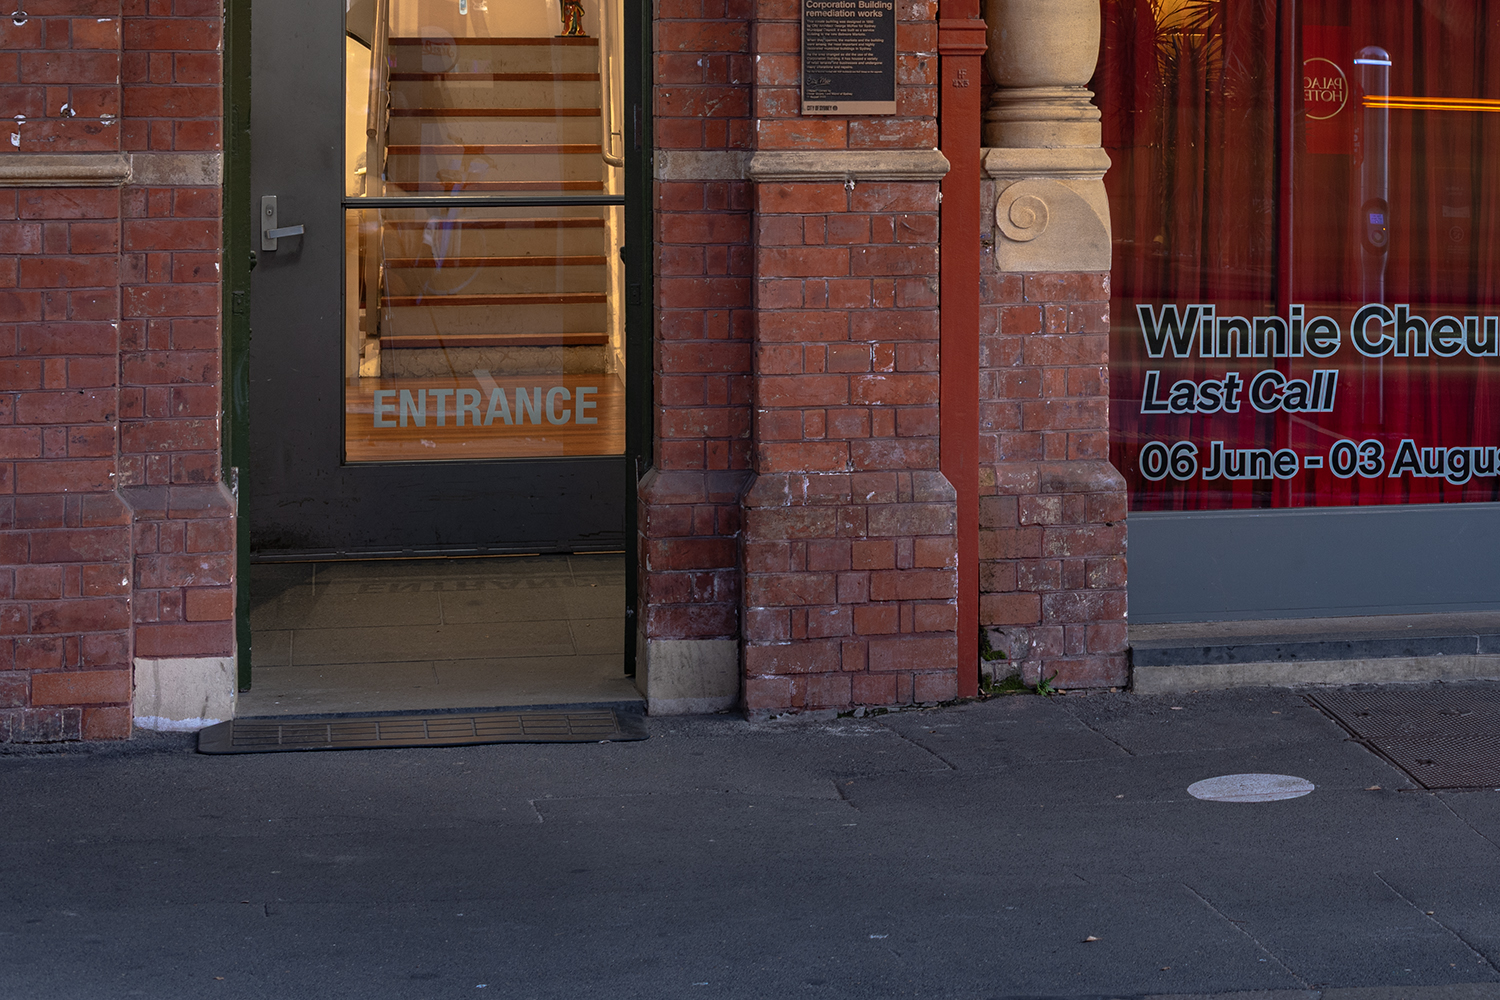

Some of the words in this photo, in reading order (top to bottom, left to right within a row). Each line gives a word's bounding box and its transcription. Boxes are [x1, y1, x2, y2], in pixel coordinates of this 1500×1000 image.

[806, 0, 856, 10] Corporation
[858, 0, 893, 10] Building
[806, 9, 855, 17] remediation
[858, 9, 883, 17] works
[1136, 303, 1341, 358] Winnie
[373, 386, 598, 428] ENTRANCE
[1140, 370, 1244, 414] Last
[1248, 369, 1339, 414] Call
[1139, 440, 1198, 481] 06
[1202, 440, 1299, 480] June
[1329, 438, 1385, 478] 03
